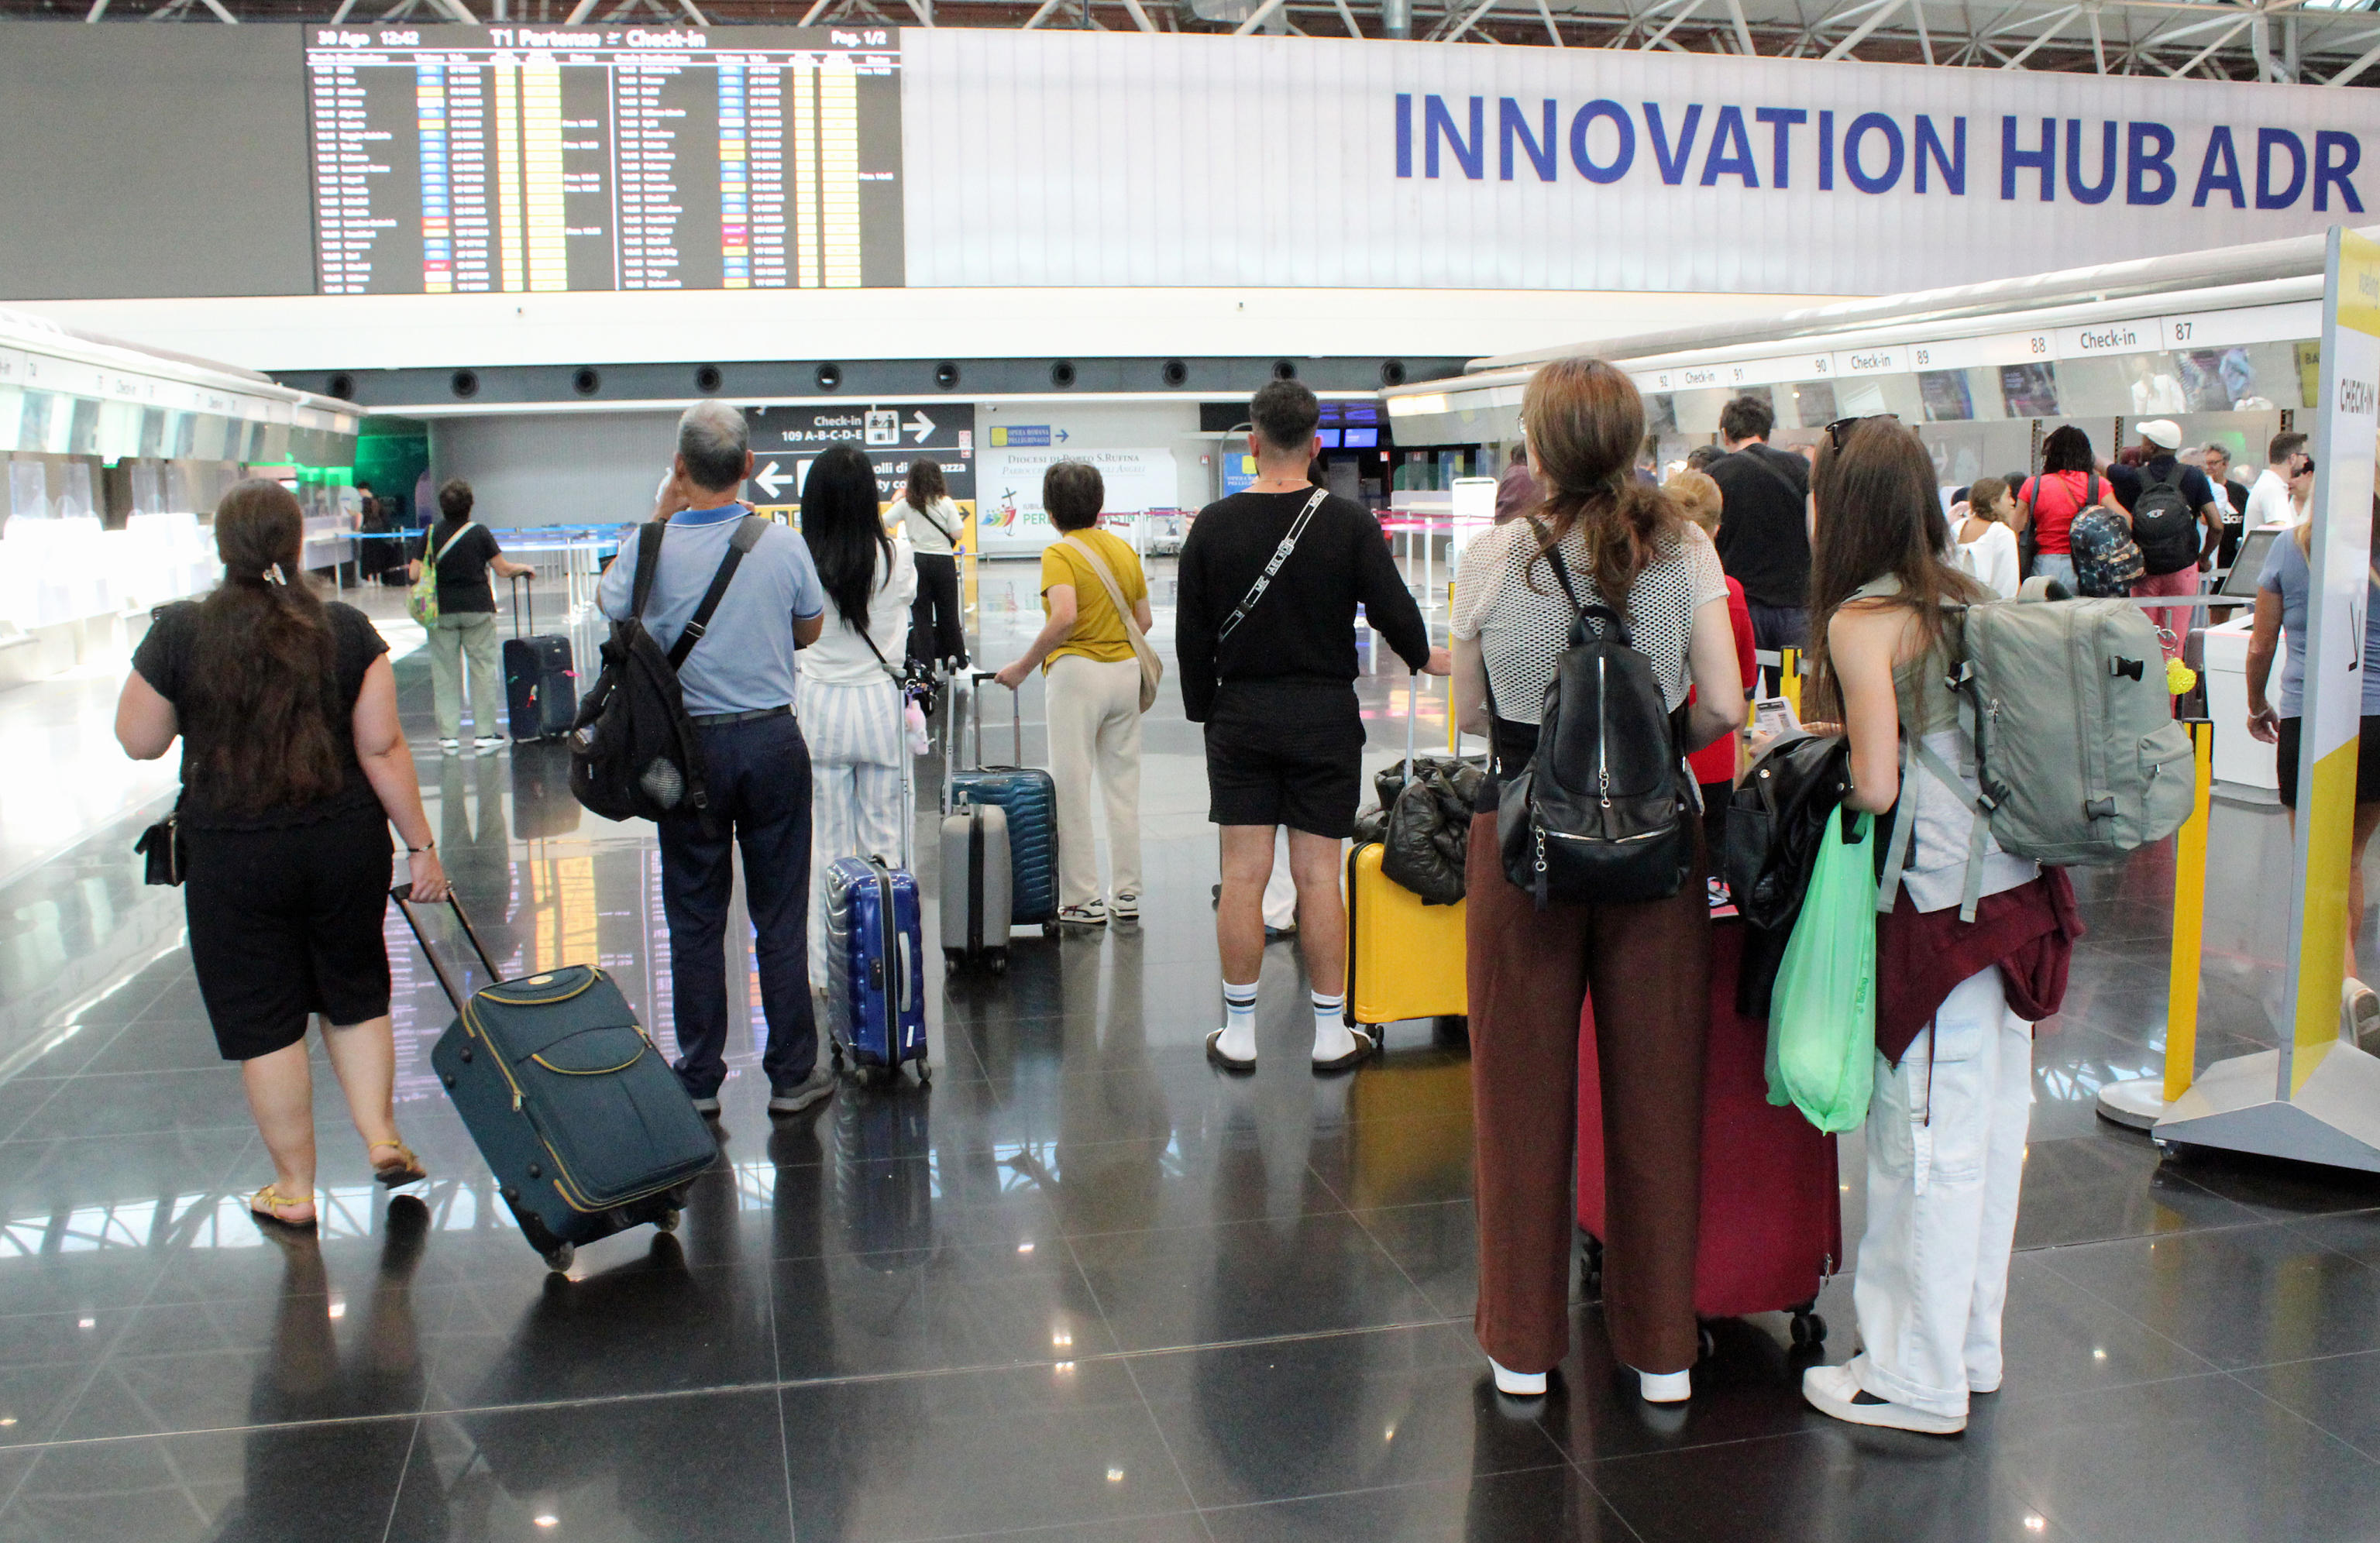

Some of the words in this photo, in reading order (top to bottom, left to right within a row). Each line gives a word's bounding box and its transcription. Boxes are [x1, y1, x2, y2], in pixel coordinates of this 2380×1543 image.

[339, 30, 370, 48] Ago
[489, 29, 513, 47] T1
[519, 29, 600, 47] Partenze
[626, 29, 707, 47] Check-in
[831, 29, 861, 47] Pag.
[863, 30, 887, 46] 1/2
[1395, 92, 1968, 198] INNOVATION
[2000, 115, 2175, 207] HUB
[2191, 125, 2366, 214] ADR
[2031, 337, 2046, 354] 88
[2080, 328, 2136, 350] Check-in
[2175, 322, 2193, 341] 87
[1815, 359, 1827, 373] 90
[1851, 352, 1891, 371] Check-in
[1916, 350, 1929, 365] 89
[2305, 352, 2320, 365] BA
[1684, 370, 1715, 386] Check-in
[1733, 367, 1744, 381] 91
[2340, 378, 2375, 414] CHECK-IN
[813, 414, 862, 427] Check-in
[781, 431, 803, 442] 109
[805, 429, 862, 442] A-B-C-D-E
